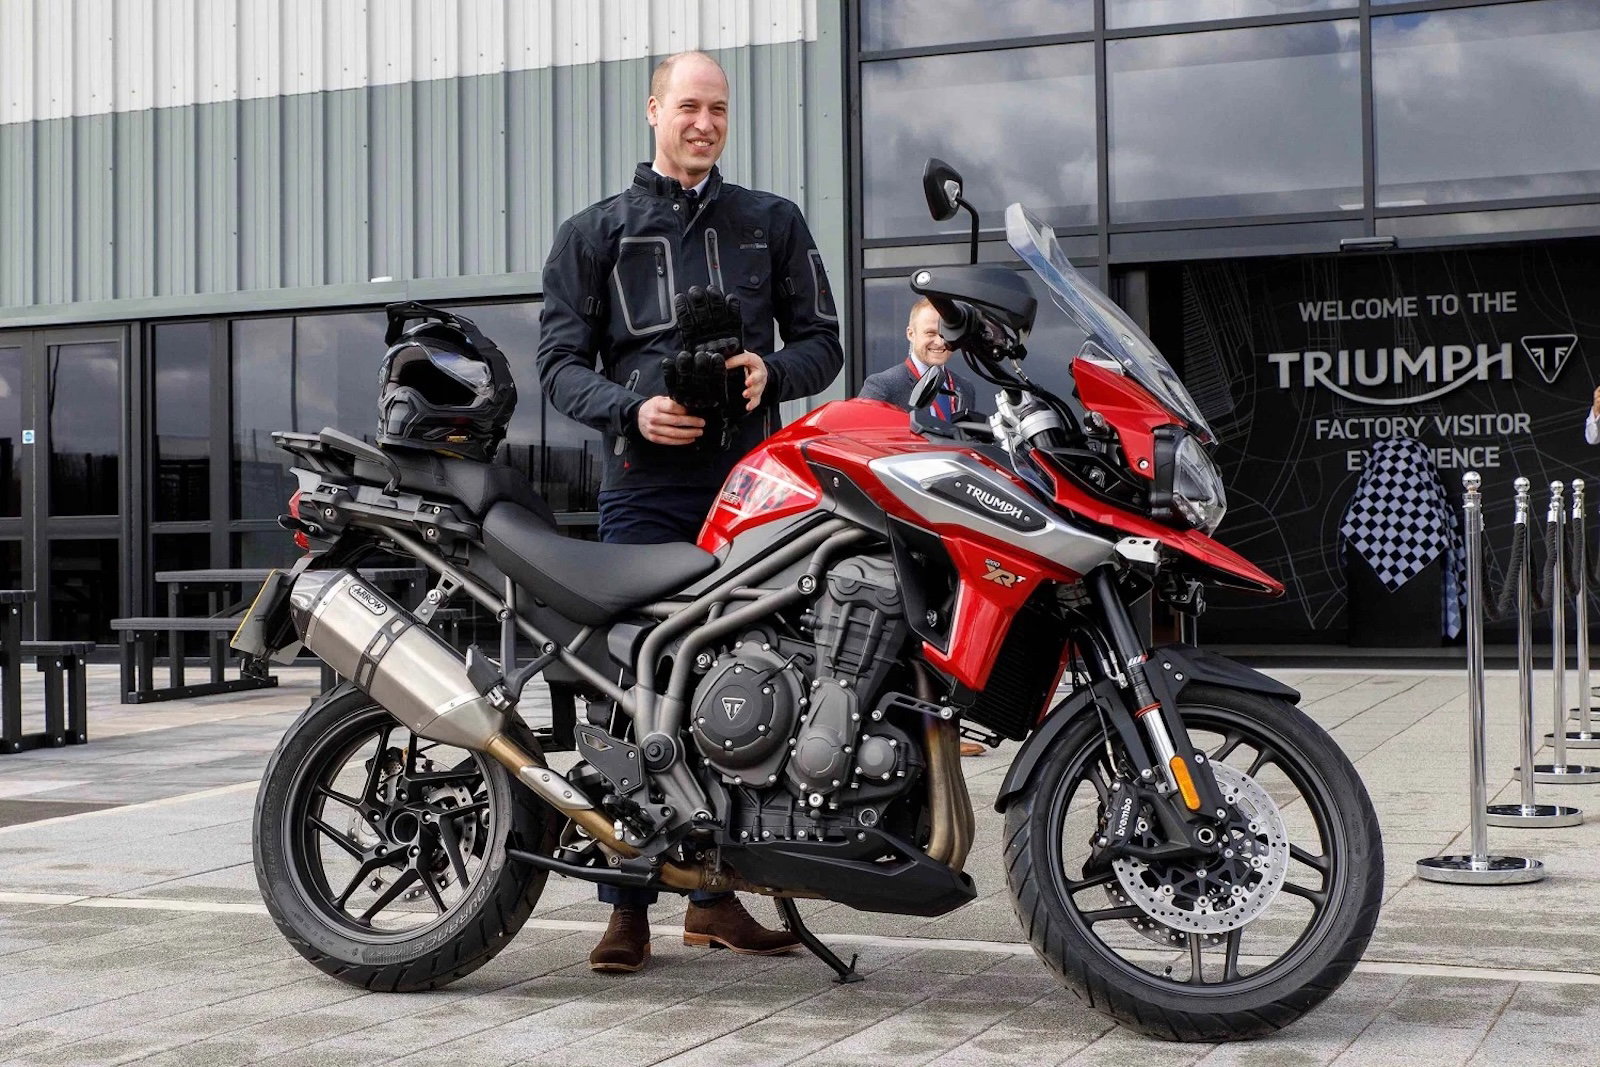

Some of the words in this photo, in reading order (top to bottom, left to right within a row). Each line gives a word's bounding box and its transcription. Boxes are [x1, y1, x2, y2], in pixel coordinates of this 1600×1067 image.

[1298, 296, 1418, 323] WELCOME
[1426, 294, 1459, 316] TO
[1467, 291, 1518, 314] THE
[1267, 342, 1514, 406] TRIUMPH
[1315, 416, 1426, 440] FACTORY
[1434, 413, 1532, 437] VISITOR
[1346, 446, 1500, 471] EIENCE
[965, 484, 1023, 519] TRIUMPH
[353, 587, 385, 610] ARROW
[1115, 798, 1132, 837] brembo
